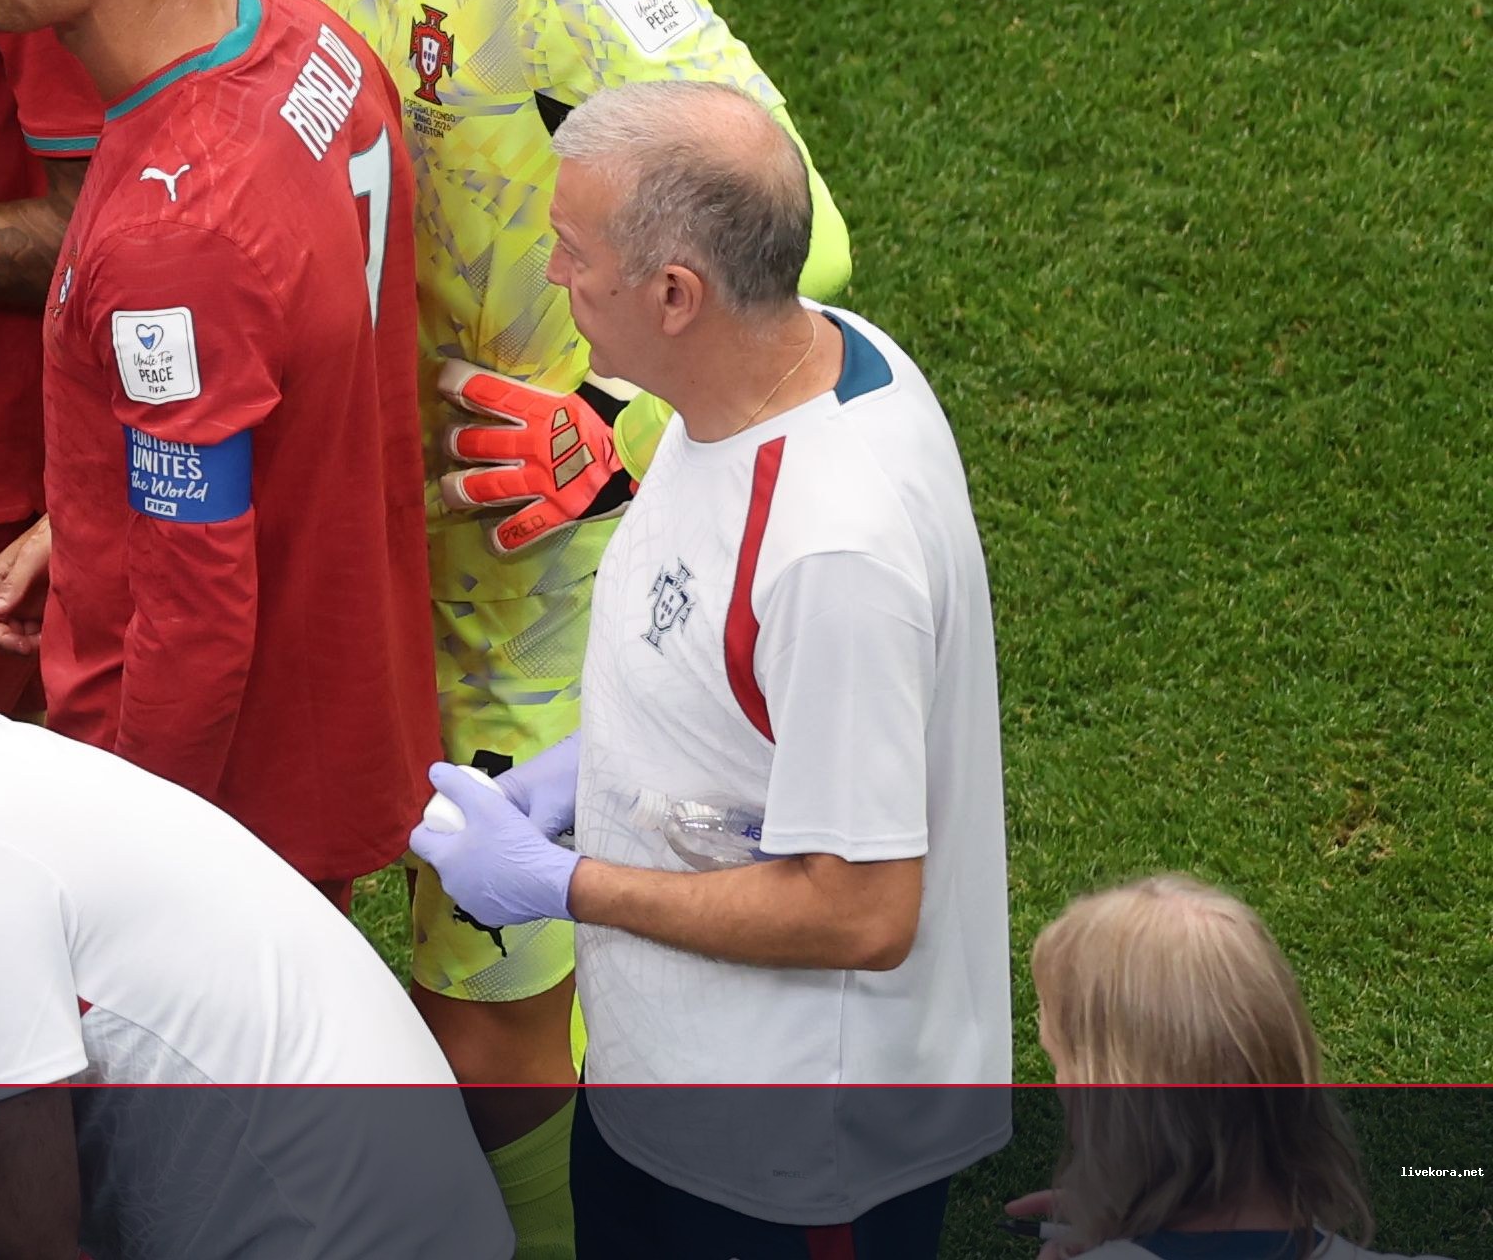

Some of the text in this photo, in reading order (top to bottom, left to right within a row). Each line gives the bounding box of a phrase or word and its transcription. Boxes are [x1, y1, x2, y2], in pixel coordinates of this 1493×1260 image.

[645, 1, 680, 30] PEACE
[279, 23, 362, 161] RONALDO
[133, 350, 174, 367] Unite For
[139, 366, 174, 383] PEACE
[148, 385, 166, 393] FIFA
[132, 447, 203, 480] UNITES
[130, 469, 210, 502] the World
[146, 498, 176, 516] FIFA
